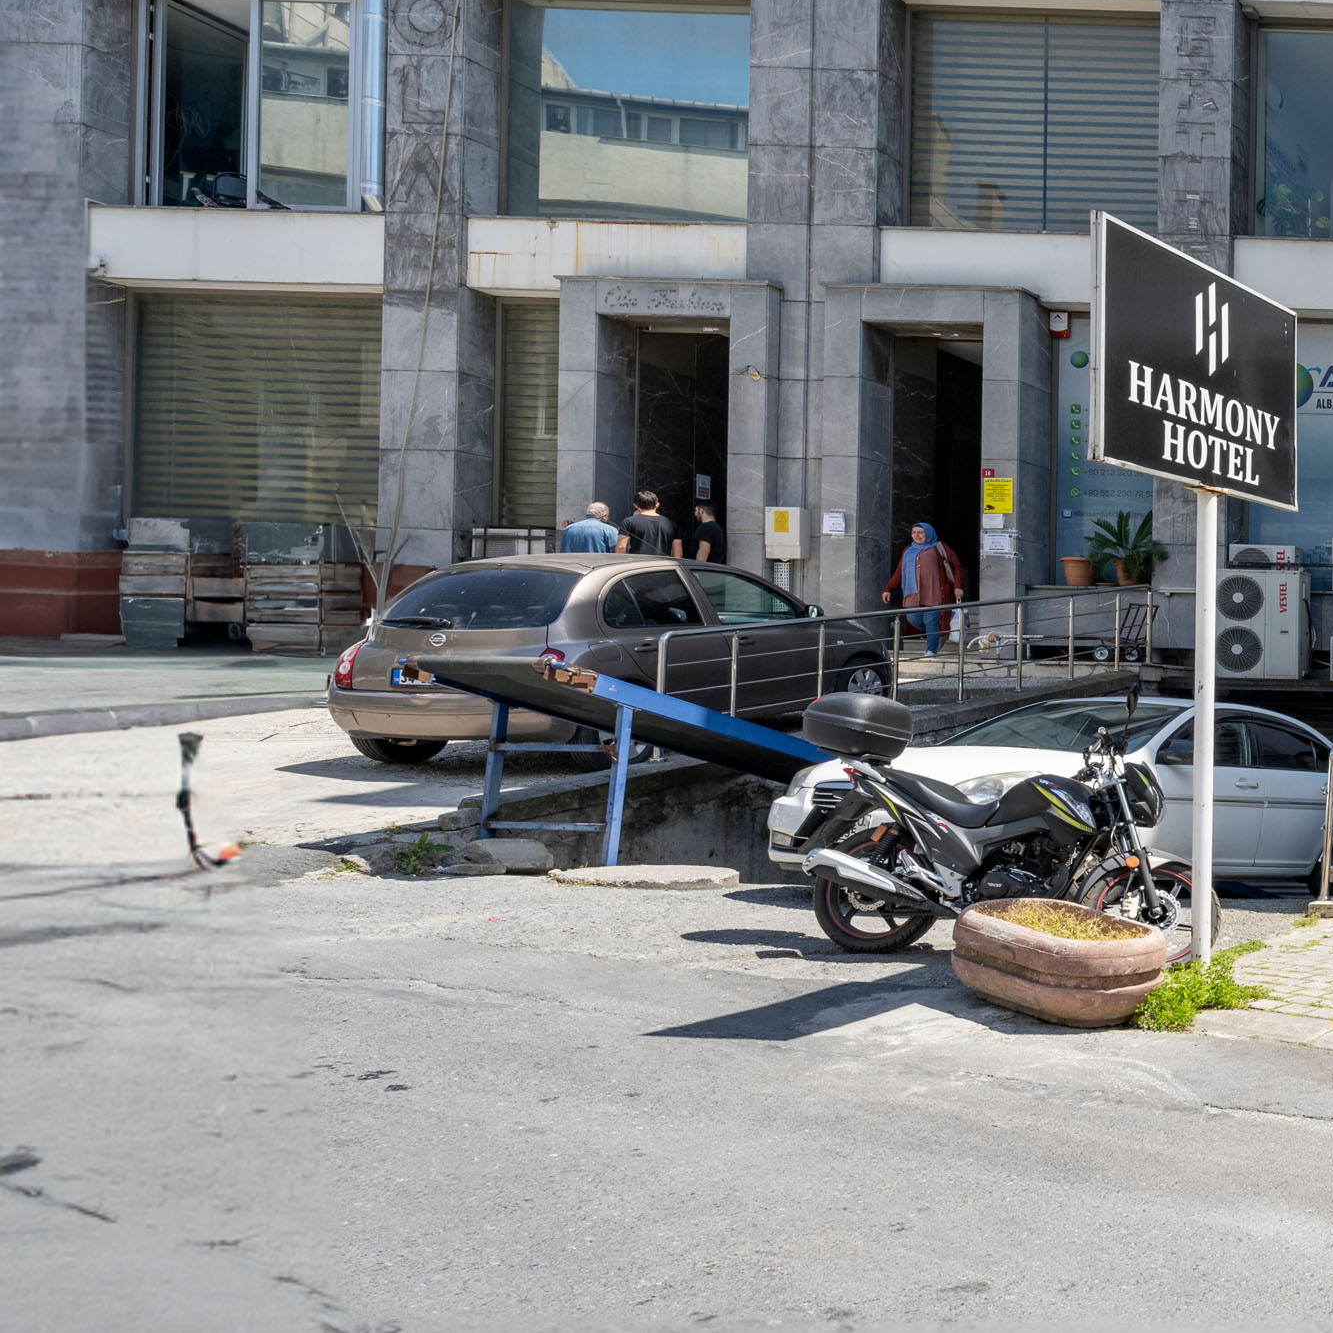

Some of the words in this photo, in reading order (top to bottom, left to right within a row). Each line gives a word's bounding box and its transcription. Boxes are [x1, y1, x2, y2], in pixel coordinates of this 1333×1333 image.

[1128, 360, 1280, 450] HARMONY
[1162, 420, 1259, 486] HOTEL
[1279, 582, 1288, 613] VESTEL
